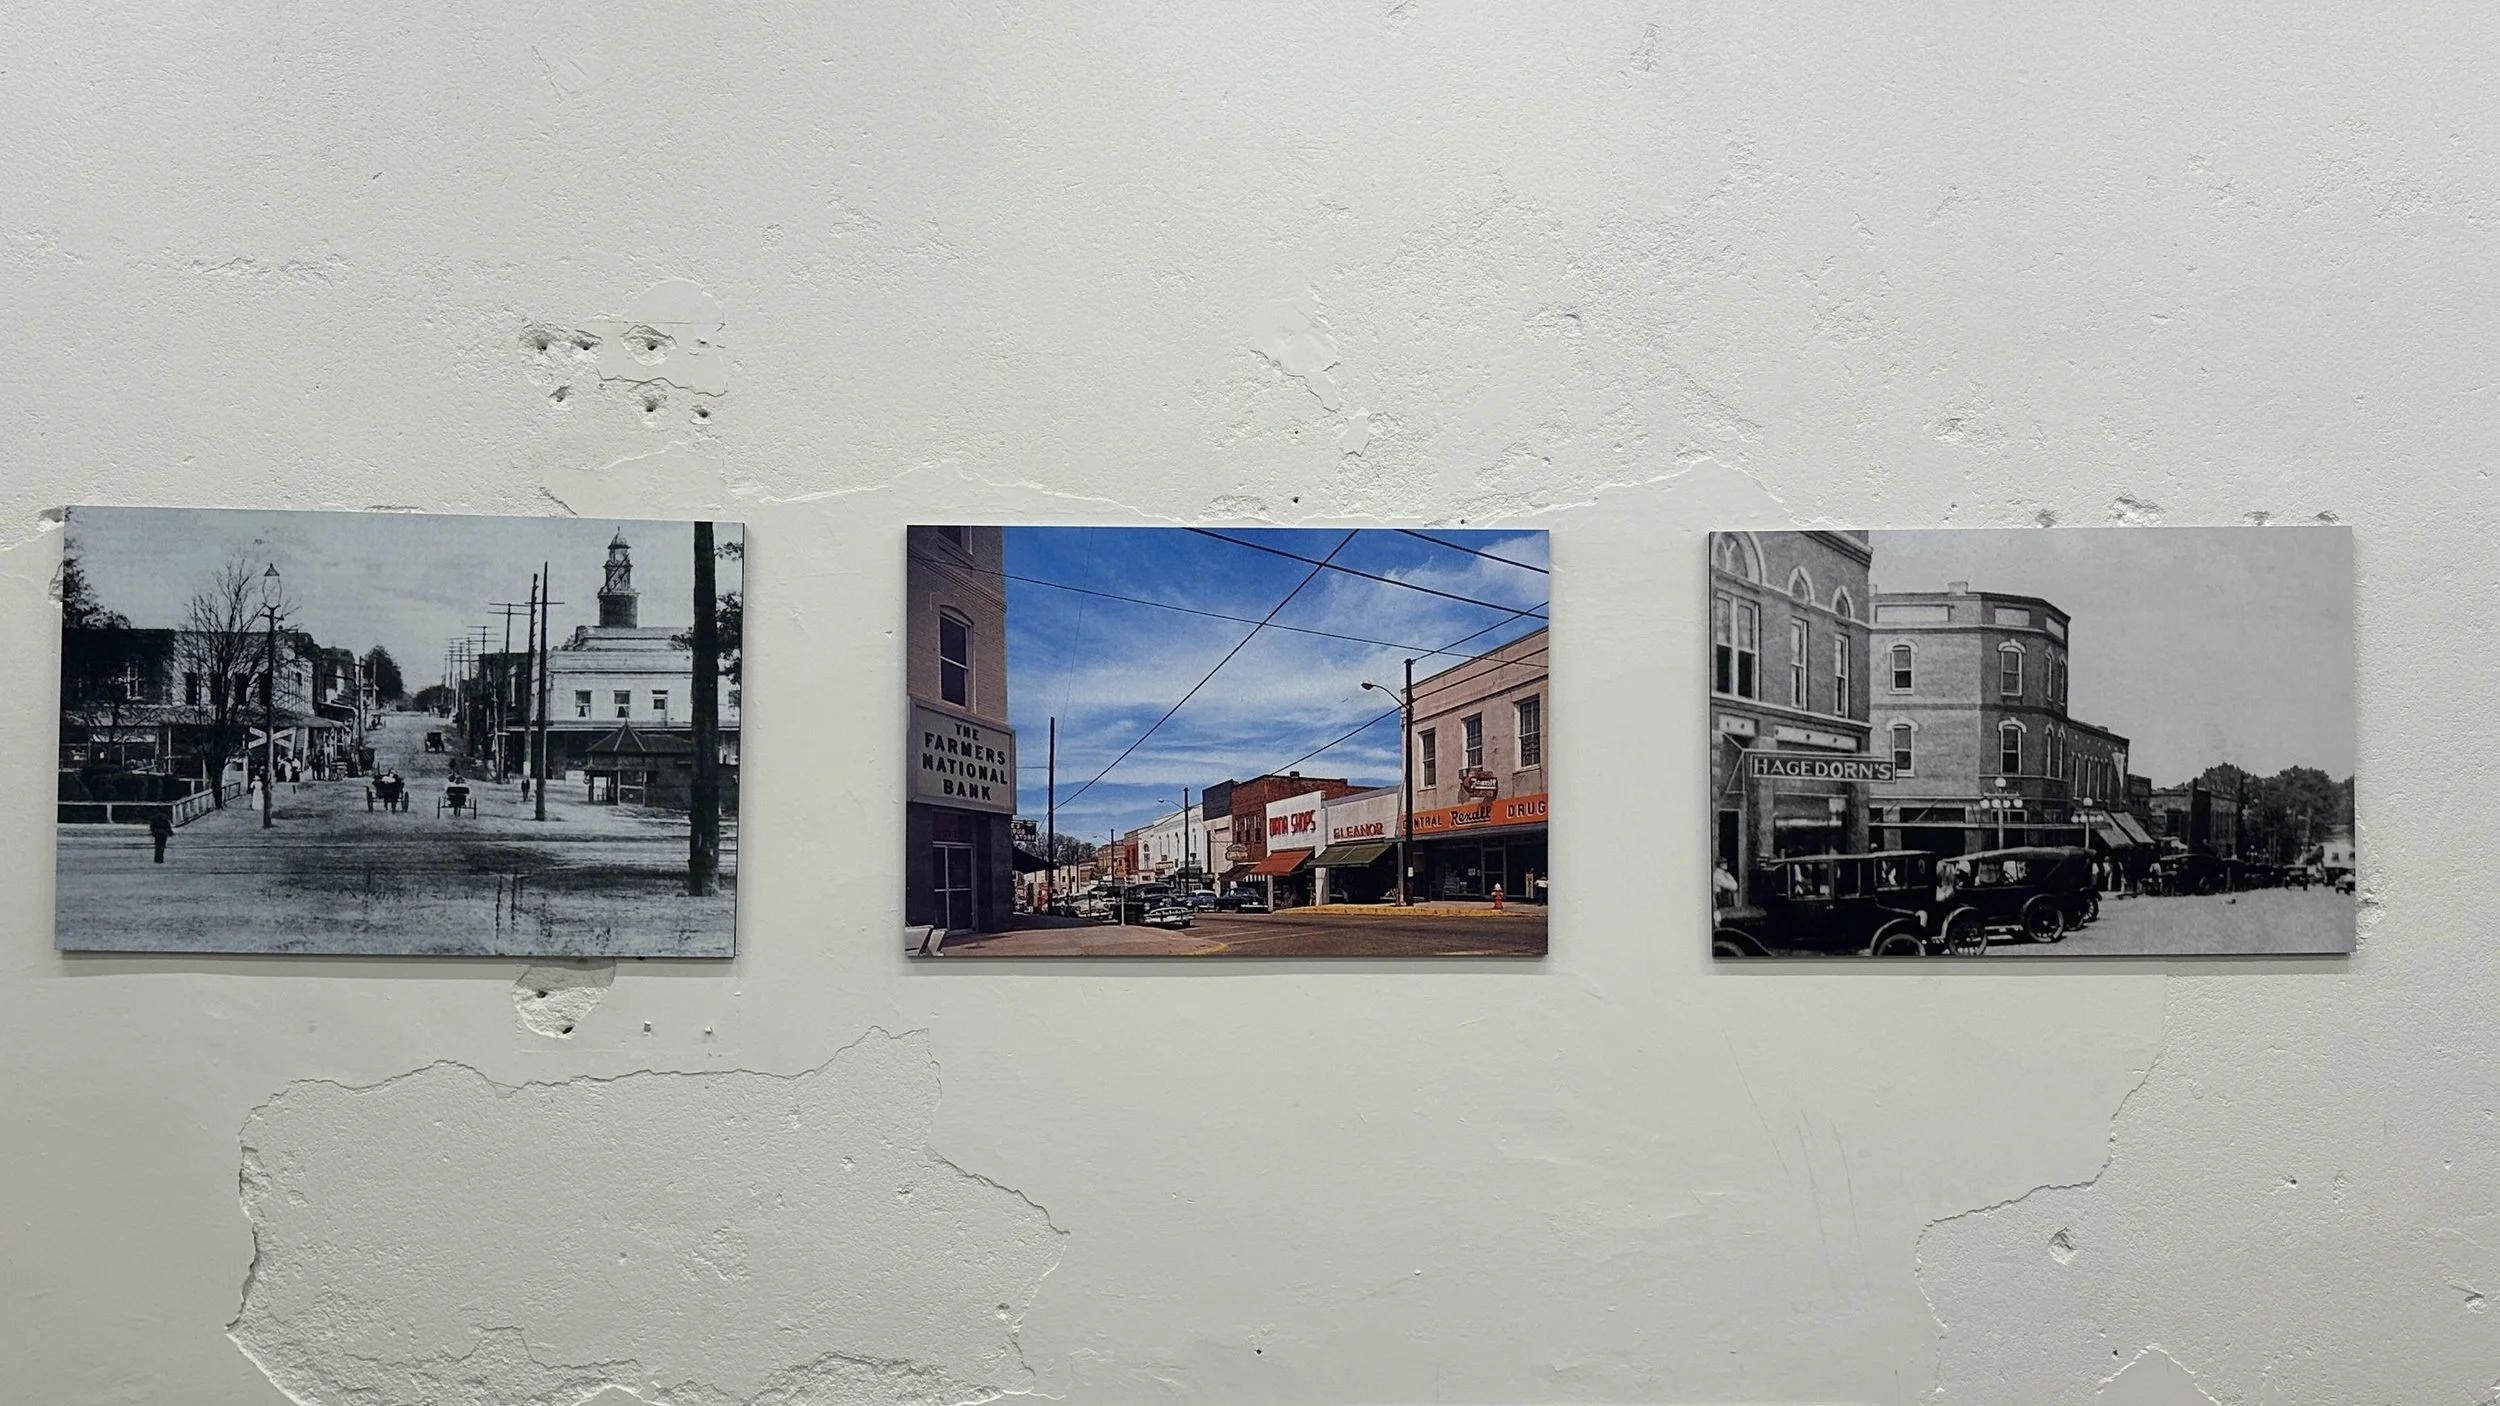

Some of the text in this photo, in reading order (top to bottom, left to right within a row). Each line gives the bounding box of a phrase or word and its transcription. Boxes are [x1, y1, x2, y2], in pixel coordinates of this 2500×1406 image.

[954, 723, 980, 741] THE
[924, 731, 1006, 765] FARMERS
[922, 752, 1008, 785] NATIONAL
[1753, 757, 1893, 780] HAGEDORN'S
[943, 778, 992, 801] BANK
[1291, 809, 1316, 834] SHOPS
[1401, 800, 1547, 831] CNTRAL Rexall DRUG
[1333, 822, 1385, 840] ELEANOR
